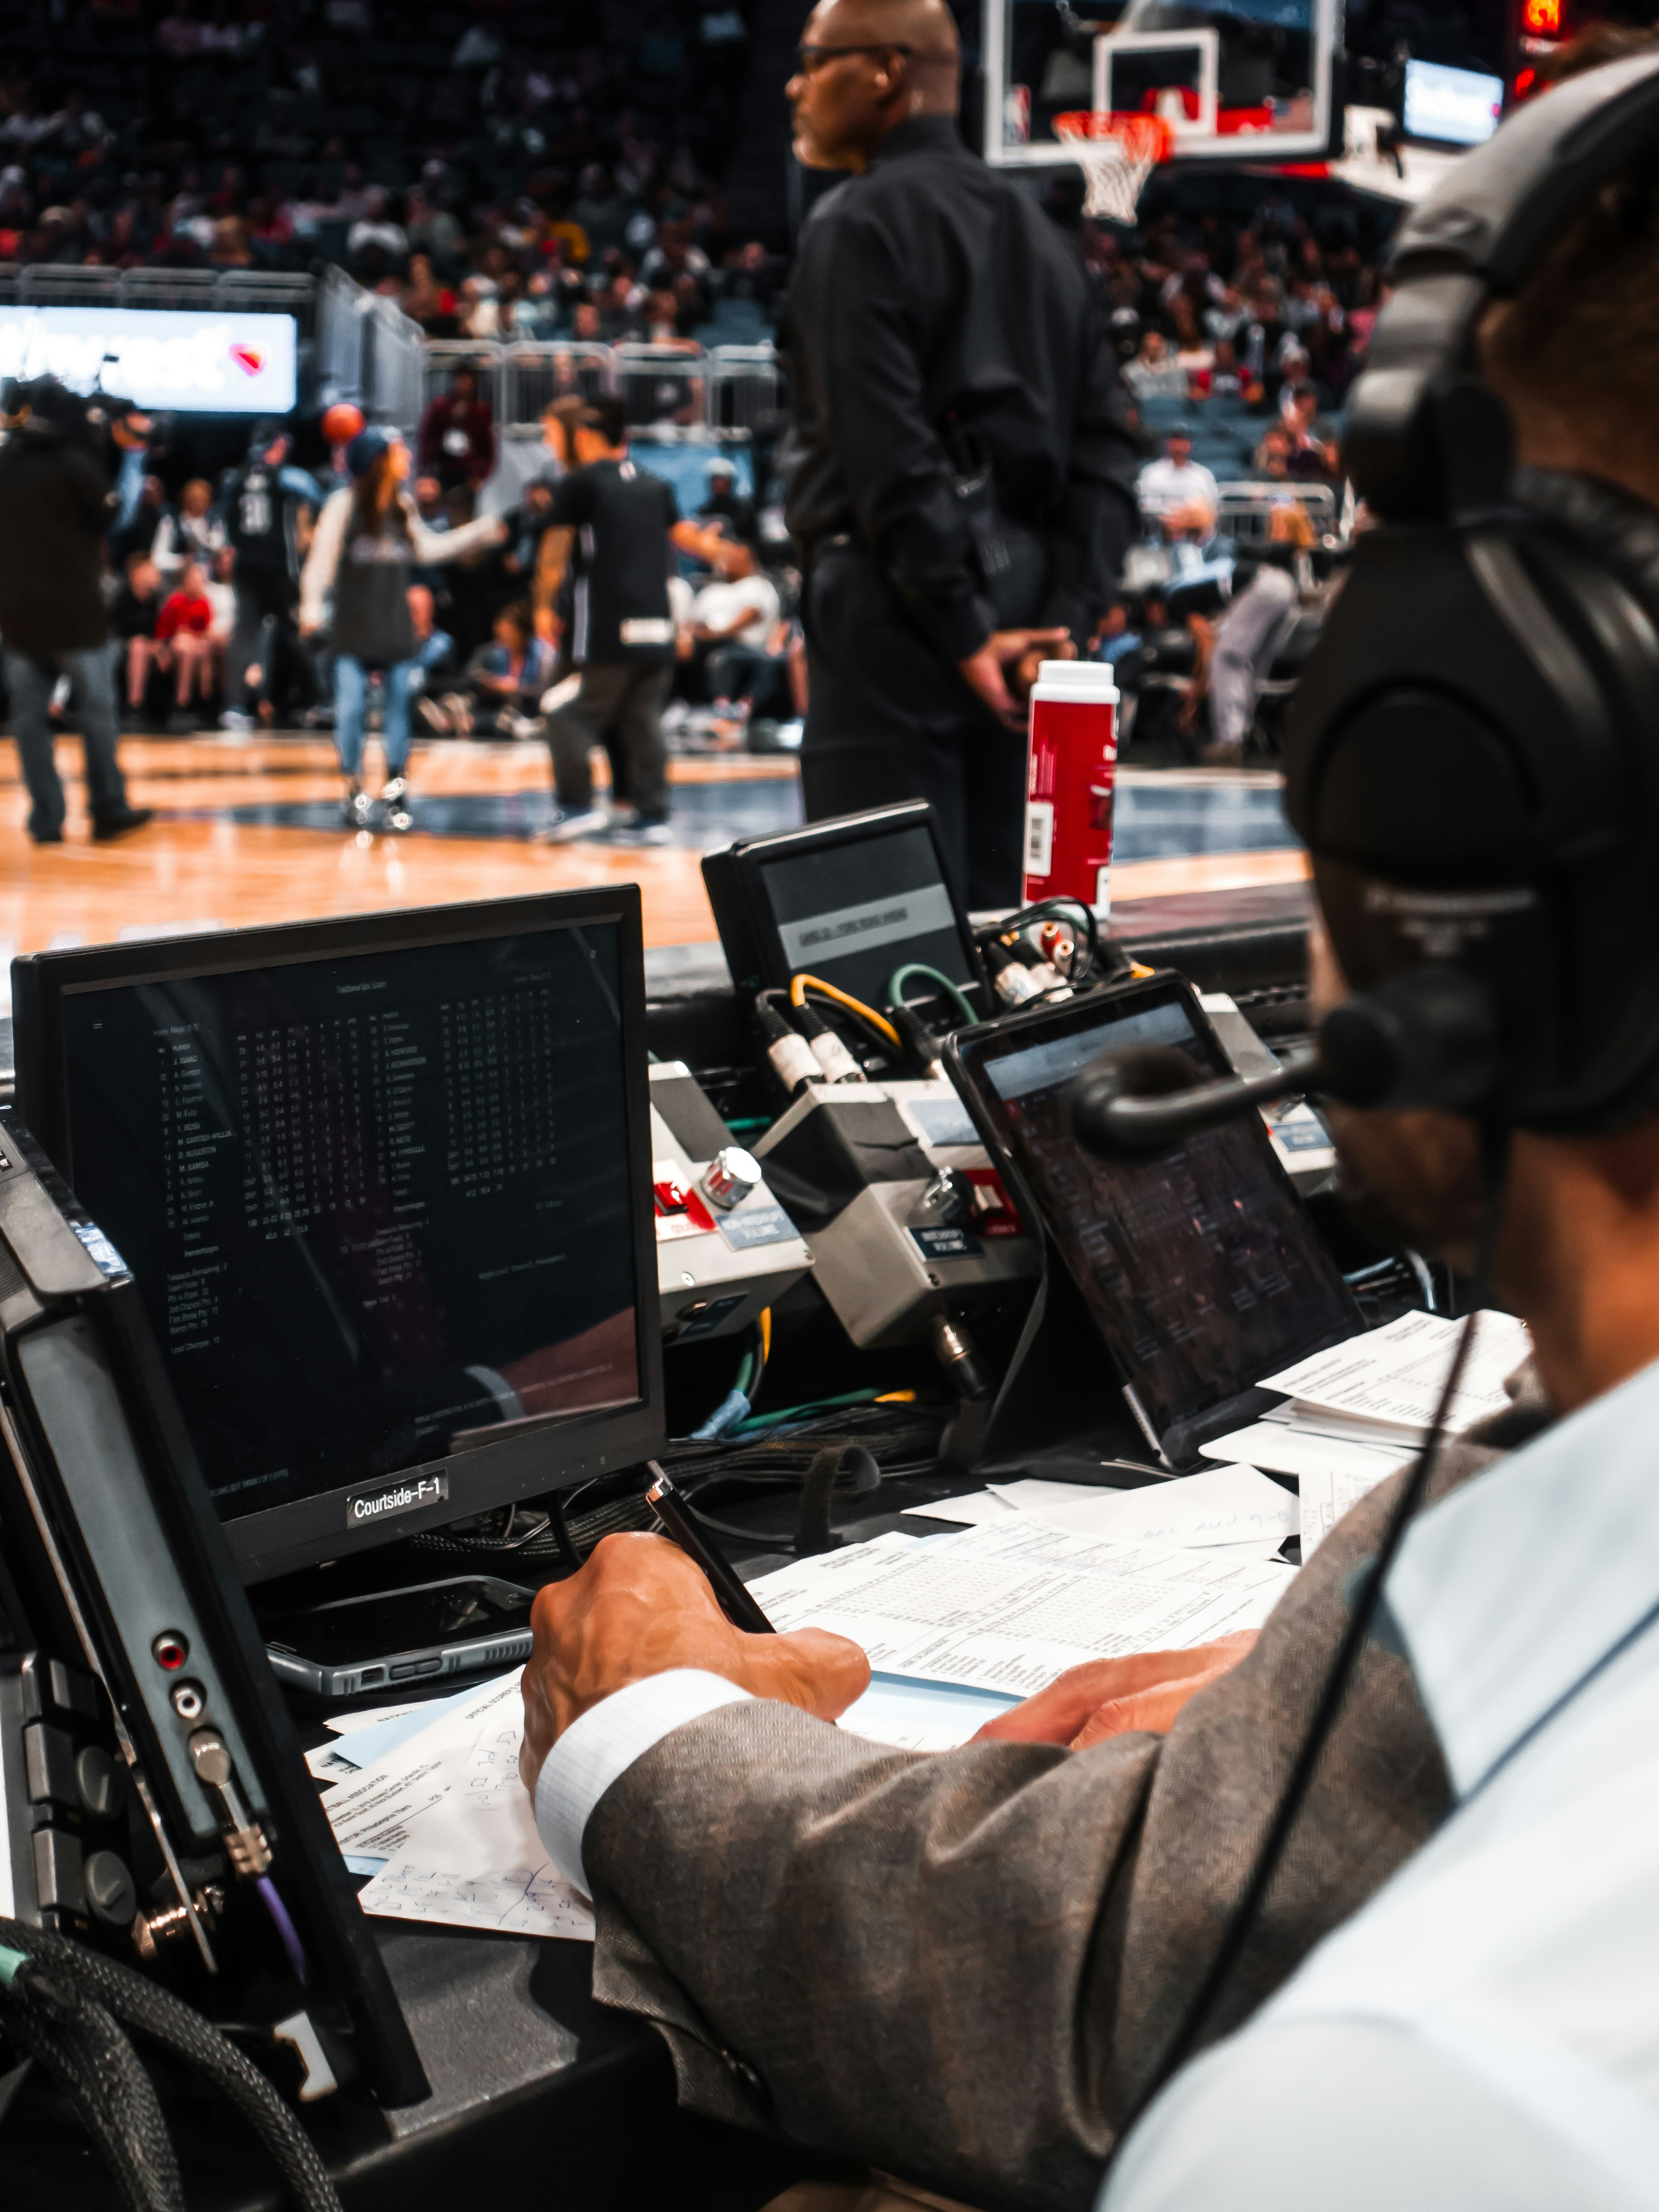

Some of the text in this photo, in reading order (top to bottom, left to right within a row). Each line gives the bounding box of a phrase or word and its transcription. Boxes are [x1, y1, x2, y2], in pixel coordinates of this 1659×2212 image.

[183, 1121, 201, 1131] ROSS
[185, 1145, 216, 1158] AUGUSTIN
[354, 1477, 440, 1518] Courtside-F-1
[465, 1704, 493, 1719] OFFICIAL
[346, 1775, 391, 1798] ASSOCIATION
